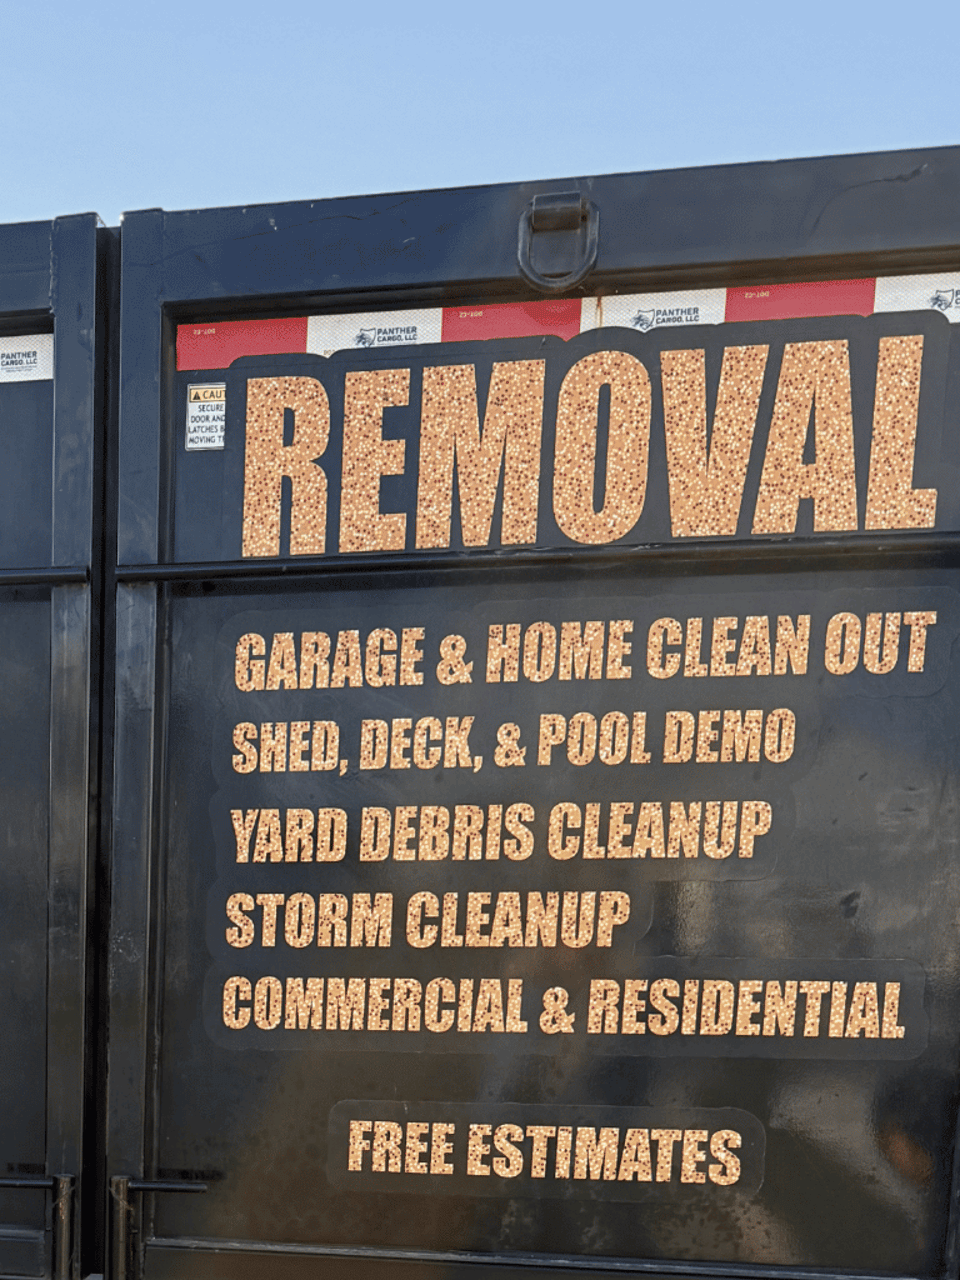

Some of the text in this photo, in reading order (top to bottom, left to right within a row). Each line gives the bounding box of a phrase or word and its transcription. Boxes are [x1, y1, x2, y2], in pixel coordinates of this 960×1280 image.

[377, 326, 418, 335] PANTHER
[655, 306, 700, 316] PANTHER
[0, 350, 37, 359] PANTHER
[190, 415, 211, 423] DOOR
[198, 404, 224, 412] SECURE
[242, 334, 937, 557] REMOVAL
[235, 611, 937, 692] GARAGE & HOME CLEAN OUT
[232, 708, 796, 776] SHED, DECK, & POOL DEMO
[230, 800, 772, 863] YARD DEBRIS CLEANUP
[225, 891, 631, 948] STORM CLEANUP
[222, 976, 905, 1039] COMMERCIAL & RESIDENTIAL
[347, 1120, 742, 1186] FREE ESTIMATES
